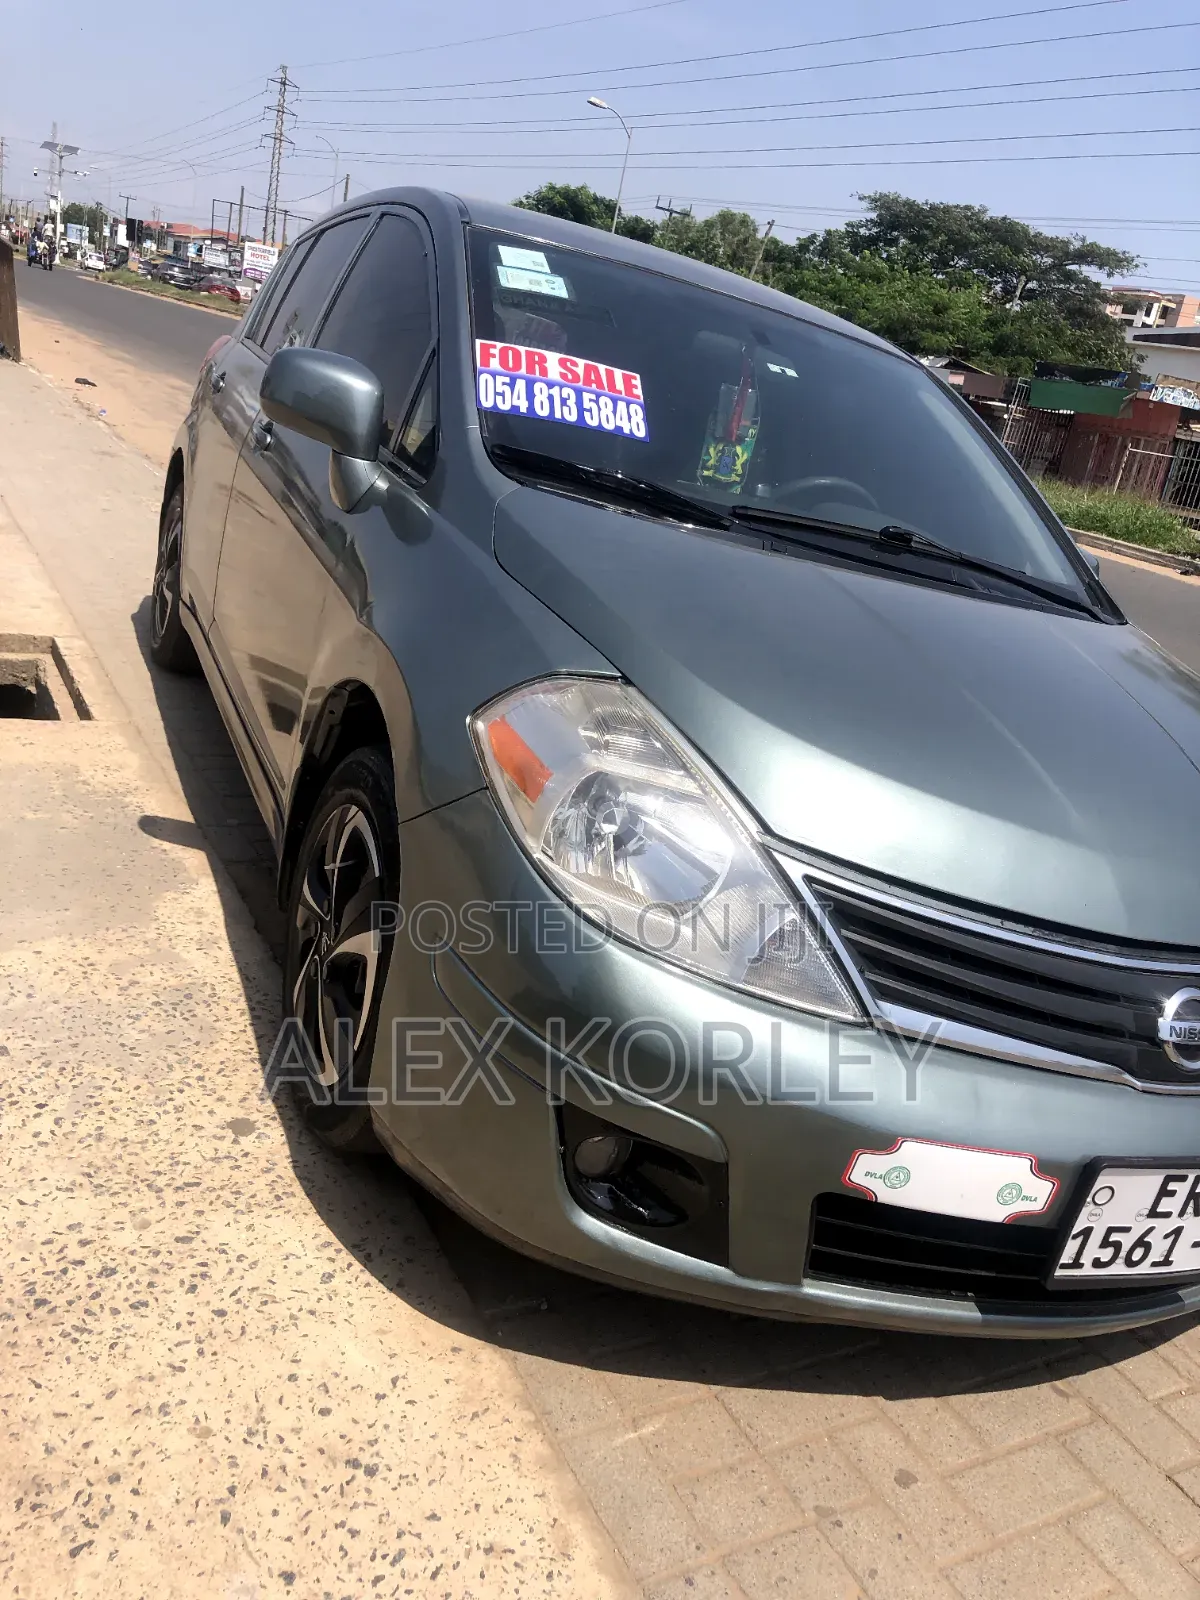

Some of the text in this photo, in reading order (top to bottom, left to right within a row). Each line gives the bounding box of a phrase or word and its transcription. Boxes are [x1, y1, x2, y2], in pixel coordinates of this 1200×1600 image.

[250, 252, 270, 262] HOTEL
[479, 342, 549, 379] FOR
[558, 356, 641, 400] SALE
[478, 373, 646, 438] 054 813 5848
[1169, 1025, 1200, 1040] NIS
[864, 1170, 884, 1180] DVLA
[1021, 1195, 1038, 1203] DVLA
